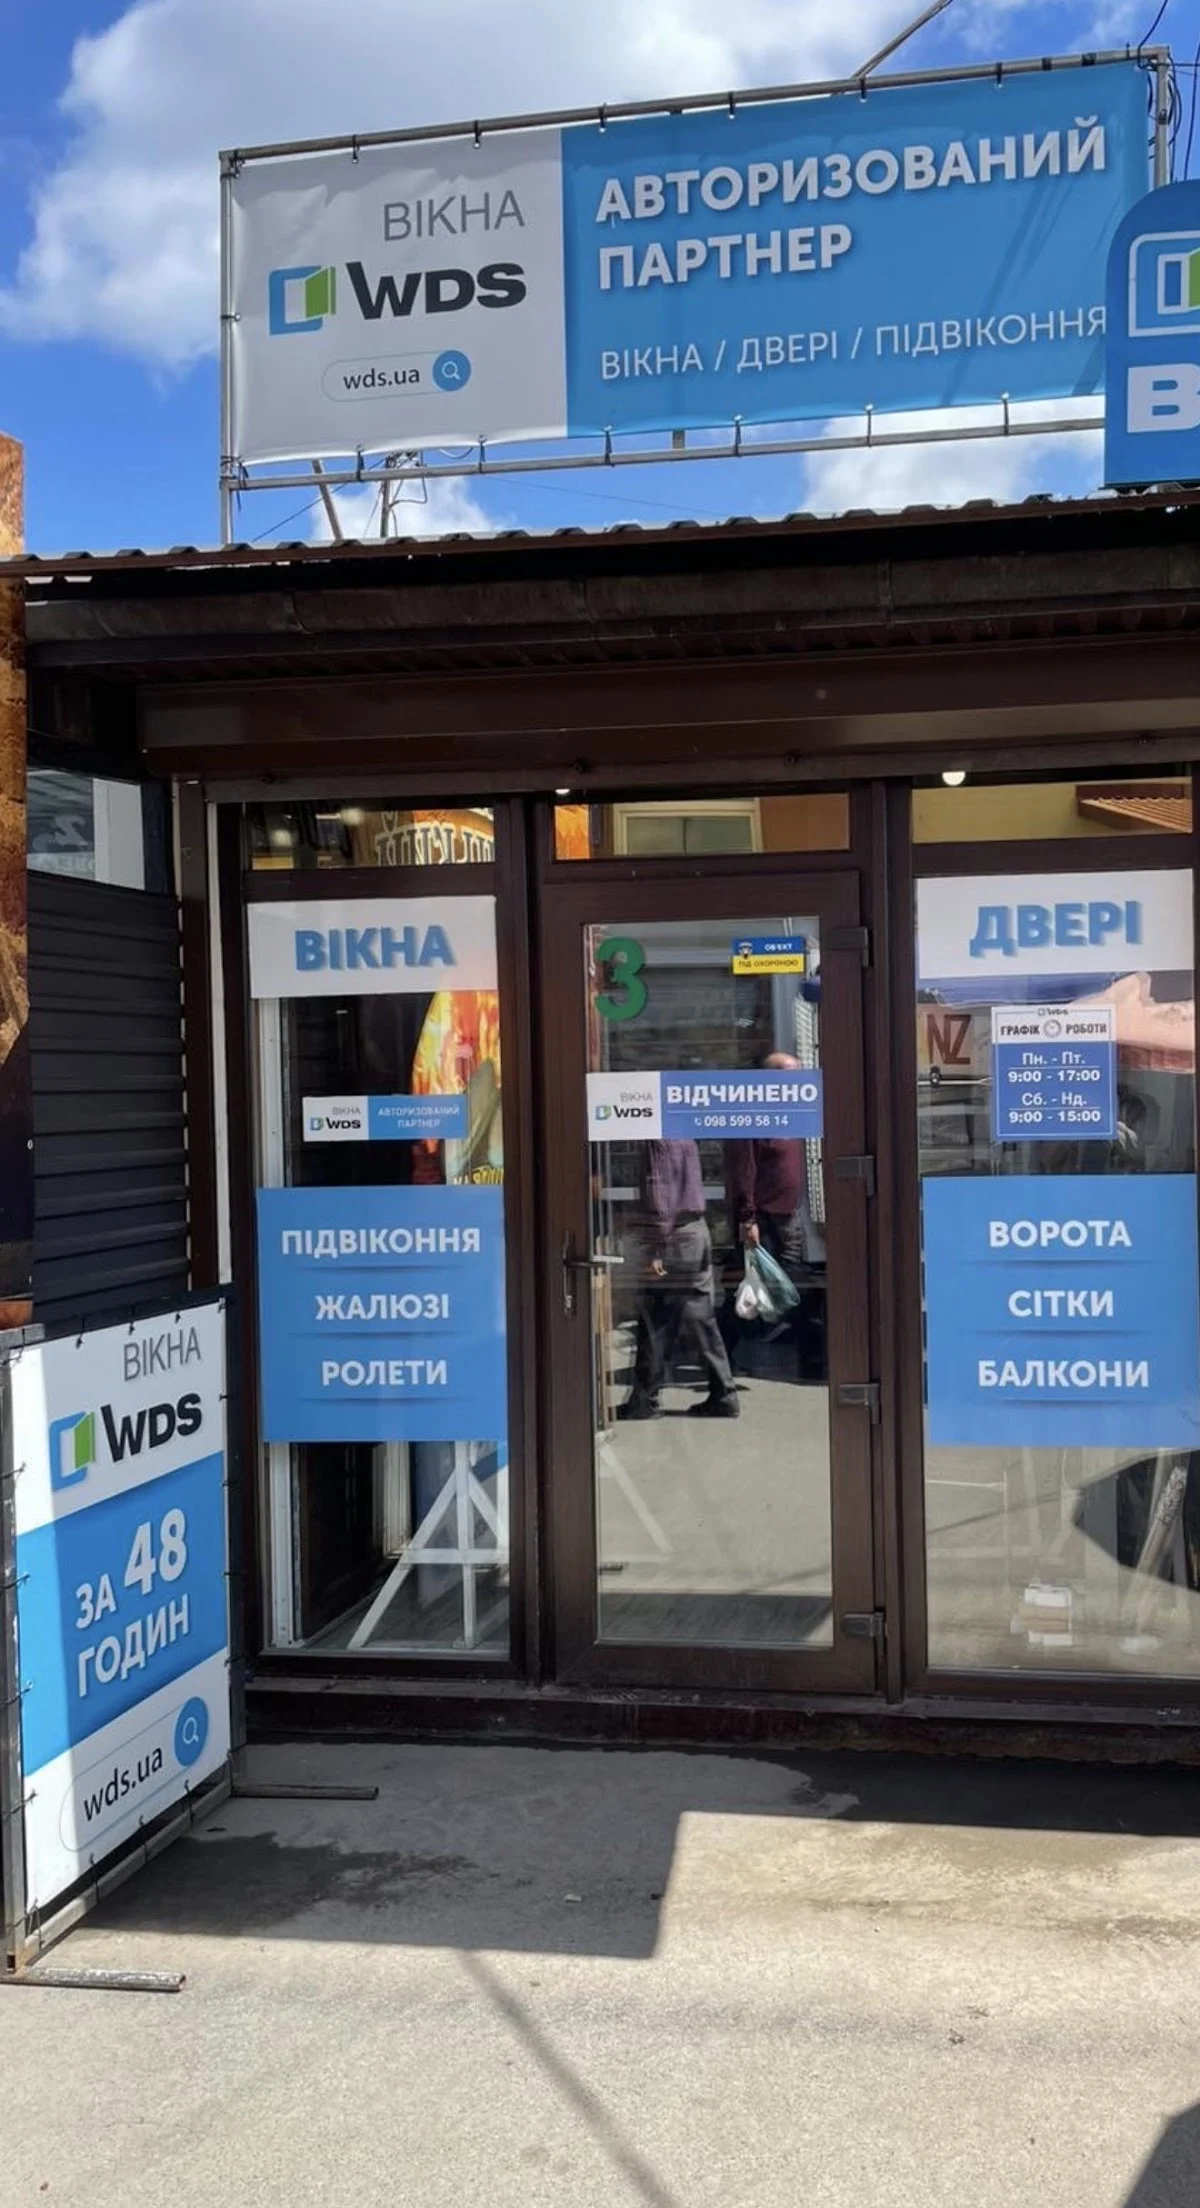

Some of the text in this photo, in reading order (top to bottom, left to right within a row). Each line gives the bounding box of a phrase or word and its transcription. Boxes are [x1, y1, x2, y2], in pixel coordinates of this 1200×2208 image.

[595, 115, 1107, 223] АВТОРИЗОВАНИЙ
[383, 189, 525, 242] ВІКНА
[599, 225, 852, 291] ПАРТНЕР
[346, 261, 528, 321] WDS
[602, 343, 703, 380] ВІКНА
[737, 331, 838, 373] ДВЕРІ
[876, 306, 1107, 357] ПІДВІКОННЯ
[343, 367, 420, 391] wds.ua
[969, 901, 1143, 958] ДВЕРІ
[294, 925, 456, 973] ВІКНА
[595, 936, 647, 1020] 3
[1000, 1023, 1107, 1036] ГРАФІК РОБОТИ
[1022, 1052, 1048, 1065] Пн.
[1061, 1051, 1086, 1065] Пт.
[1007, 1071, 1042, 1082] 9:00
[1057, 1069, 1101, 1082] 17:00
[666, 1084, 818, 1107] ВІДЧИНЕНО
[1021, 1092, 1047, 1106] Сб.
[1061, 1092, 1087, 1107] Нд.
[325, 1117, 361, 1130] WDS
[378, 1105, 461, 1117] АВТОРИЗОВАНИЙ
[396, 1119, 442, 1129] ПАРТНЕР
[613, 1105, 653, 1118] WDS
[704, 1114, 789, 1127] 098 599 58 14
[1008, 1111, 1043, 1123] 9:00
[1057, 1110, 1101, 1122] 15:00
[281, 1228, 481, 1259] ПІДВІКОННЯ
[989, 1220, 1132, 1248] ВОРОТА
[315, 1294, 449, 1321] ЖАЛЮЗІ
[1008, 1290, 1114, 1318] СІТКИ
[123, 1329, 202, 1382] ВІКНА
[322, 1360, 448, 1387] РОЛЕТИ
[978, 1360, 1149, 1388] БАЛКОНИ
[100, 1392, 203, 1464] WDS
[75, 1508, 188, 1630] ЗА 48
[78, 1592, 191, 1698] ГОДИН
[82, 1745, 164, 1823] wds.ua
